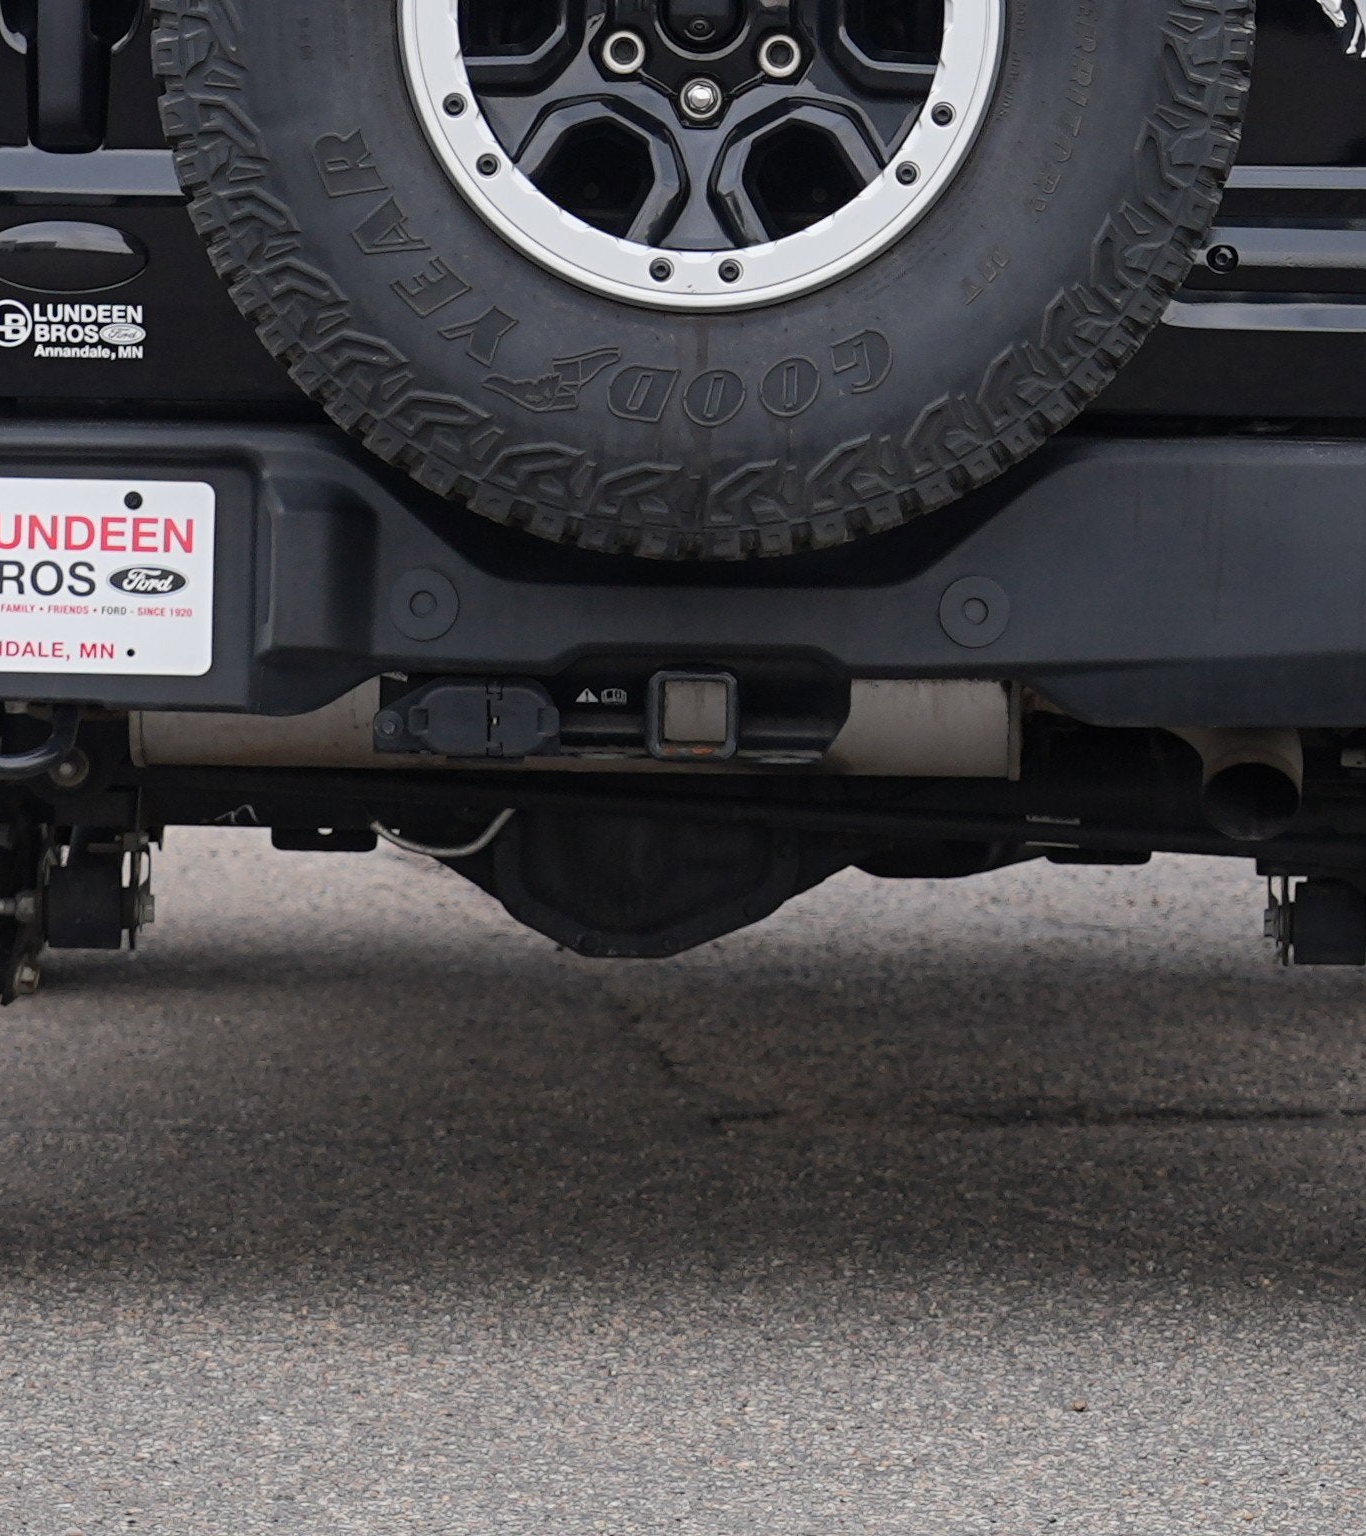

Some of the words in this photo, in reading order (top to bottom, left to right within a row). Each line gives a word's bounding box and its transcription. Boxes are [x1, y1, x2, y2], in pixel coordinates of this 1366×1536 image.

[33, 303, 144, 324] LUNDEEN
[34, 324, 100, 344] BROS
[34, 344, 117, 360] Annandale,
[118, 345, 144, 359] MN
[121, 566, 175, 593] Ford
[0, 603, 36, 614] FAMILY
[47, 604, 90, 615] FRIENDS
[101, 606, 127, 616] FORD
[137, 607, 167, 617] SINCE
[79, 643, 115, 659] MN
